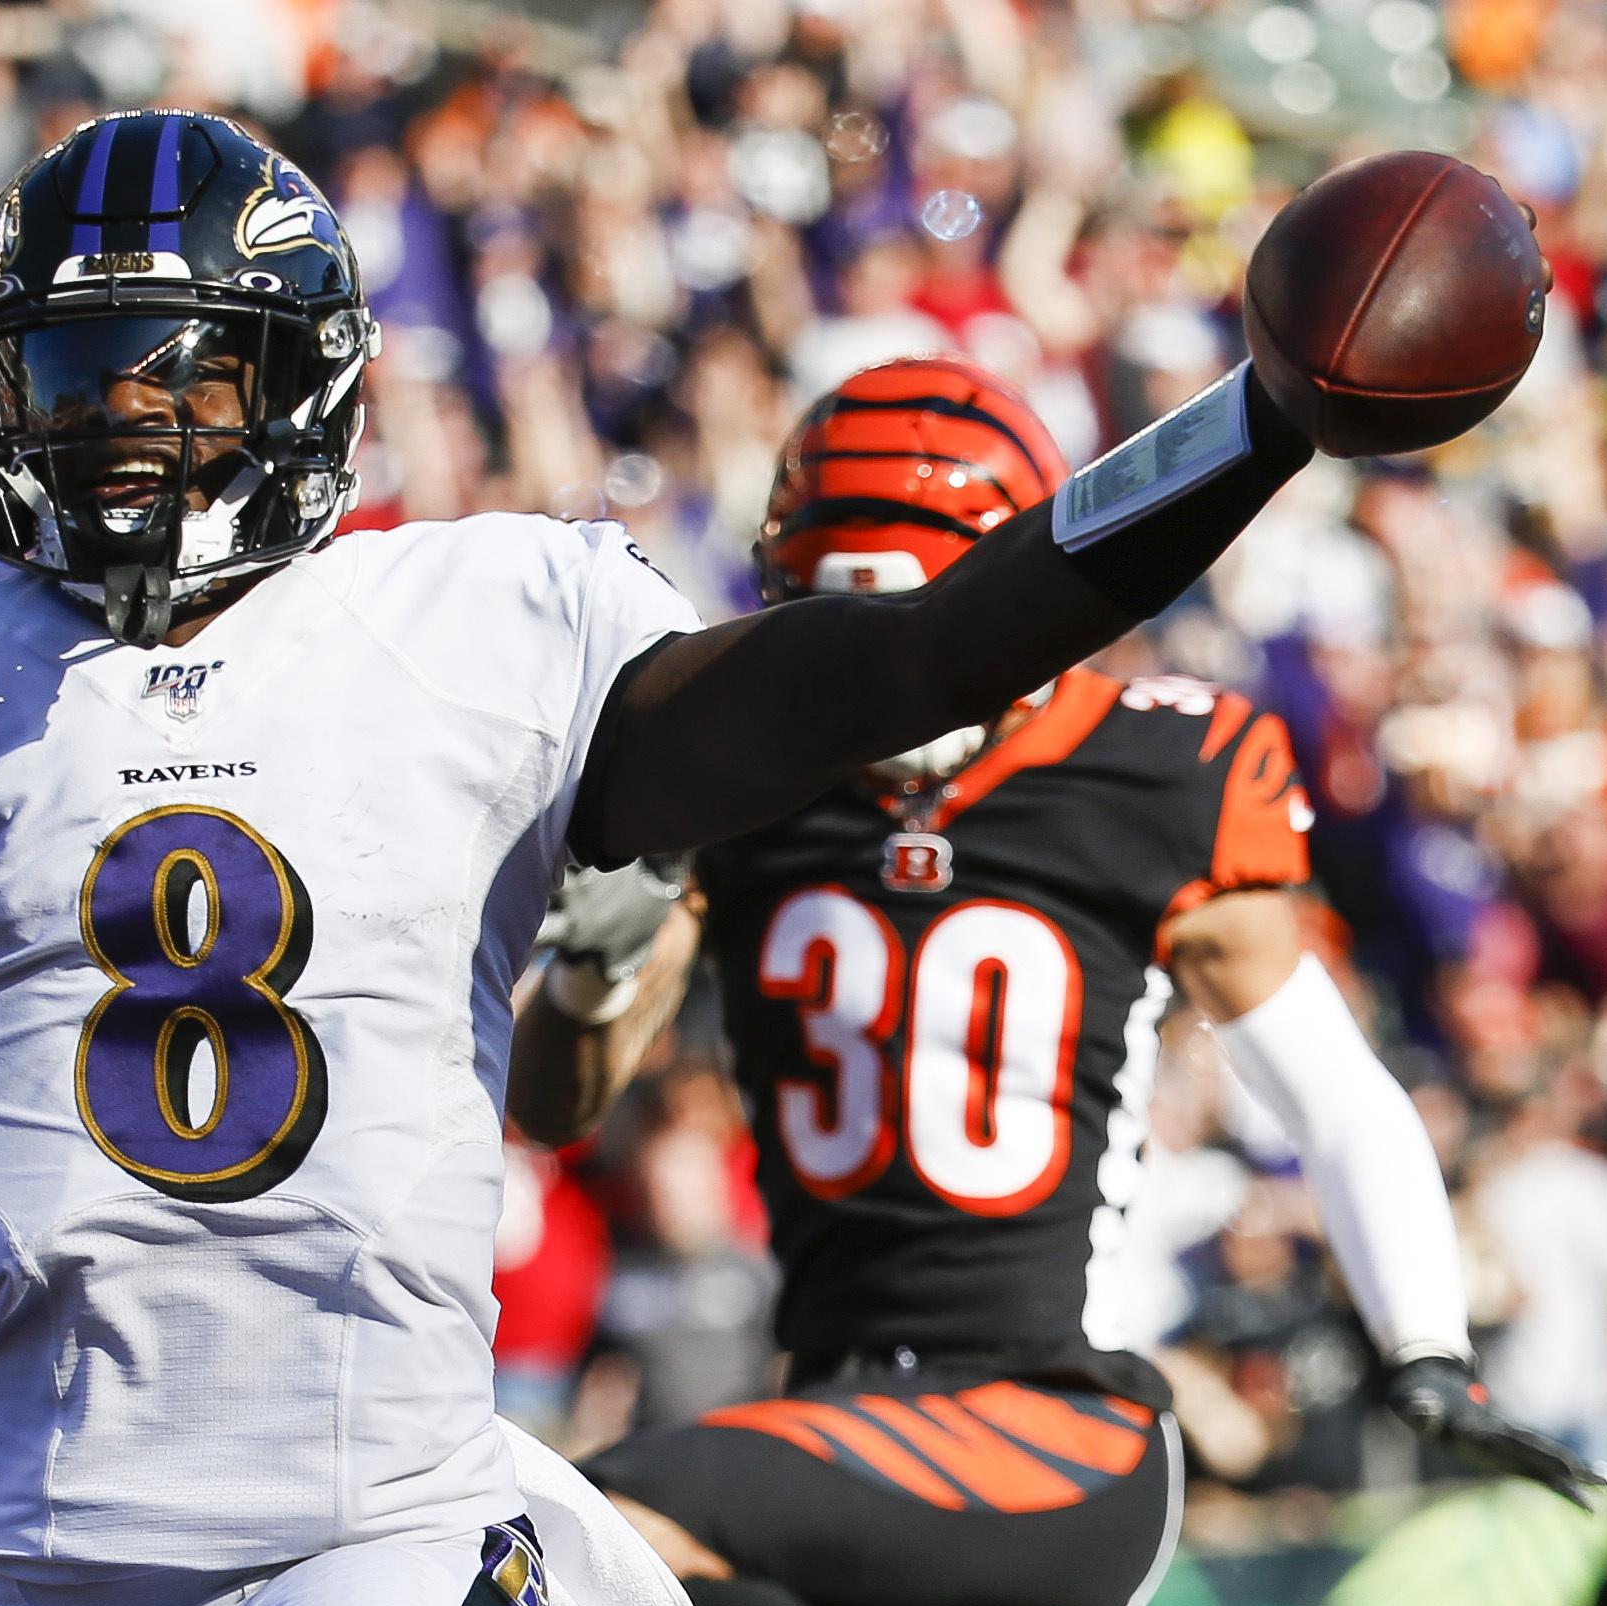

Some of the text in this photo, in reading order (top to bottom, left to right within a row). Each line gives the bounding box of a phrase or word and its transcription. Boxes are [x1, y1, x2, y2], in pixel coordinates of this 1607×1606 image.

[117, 761, 258, 786] RAVENS
[74, 804, 329, 1204] 8
[756, 882, 1085, 1219] 30
